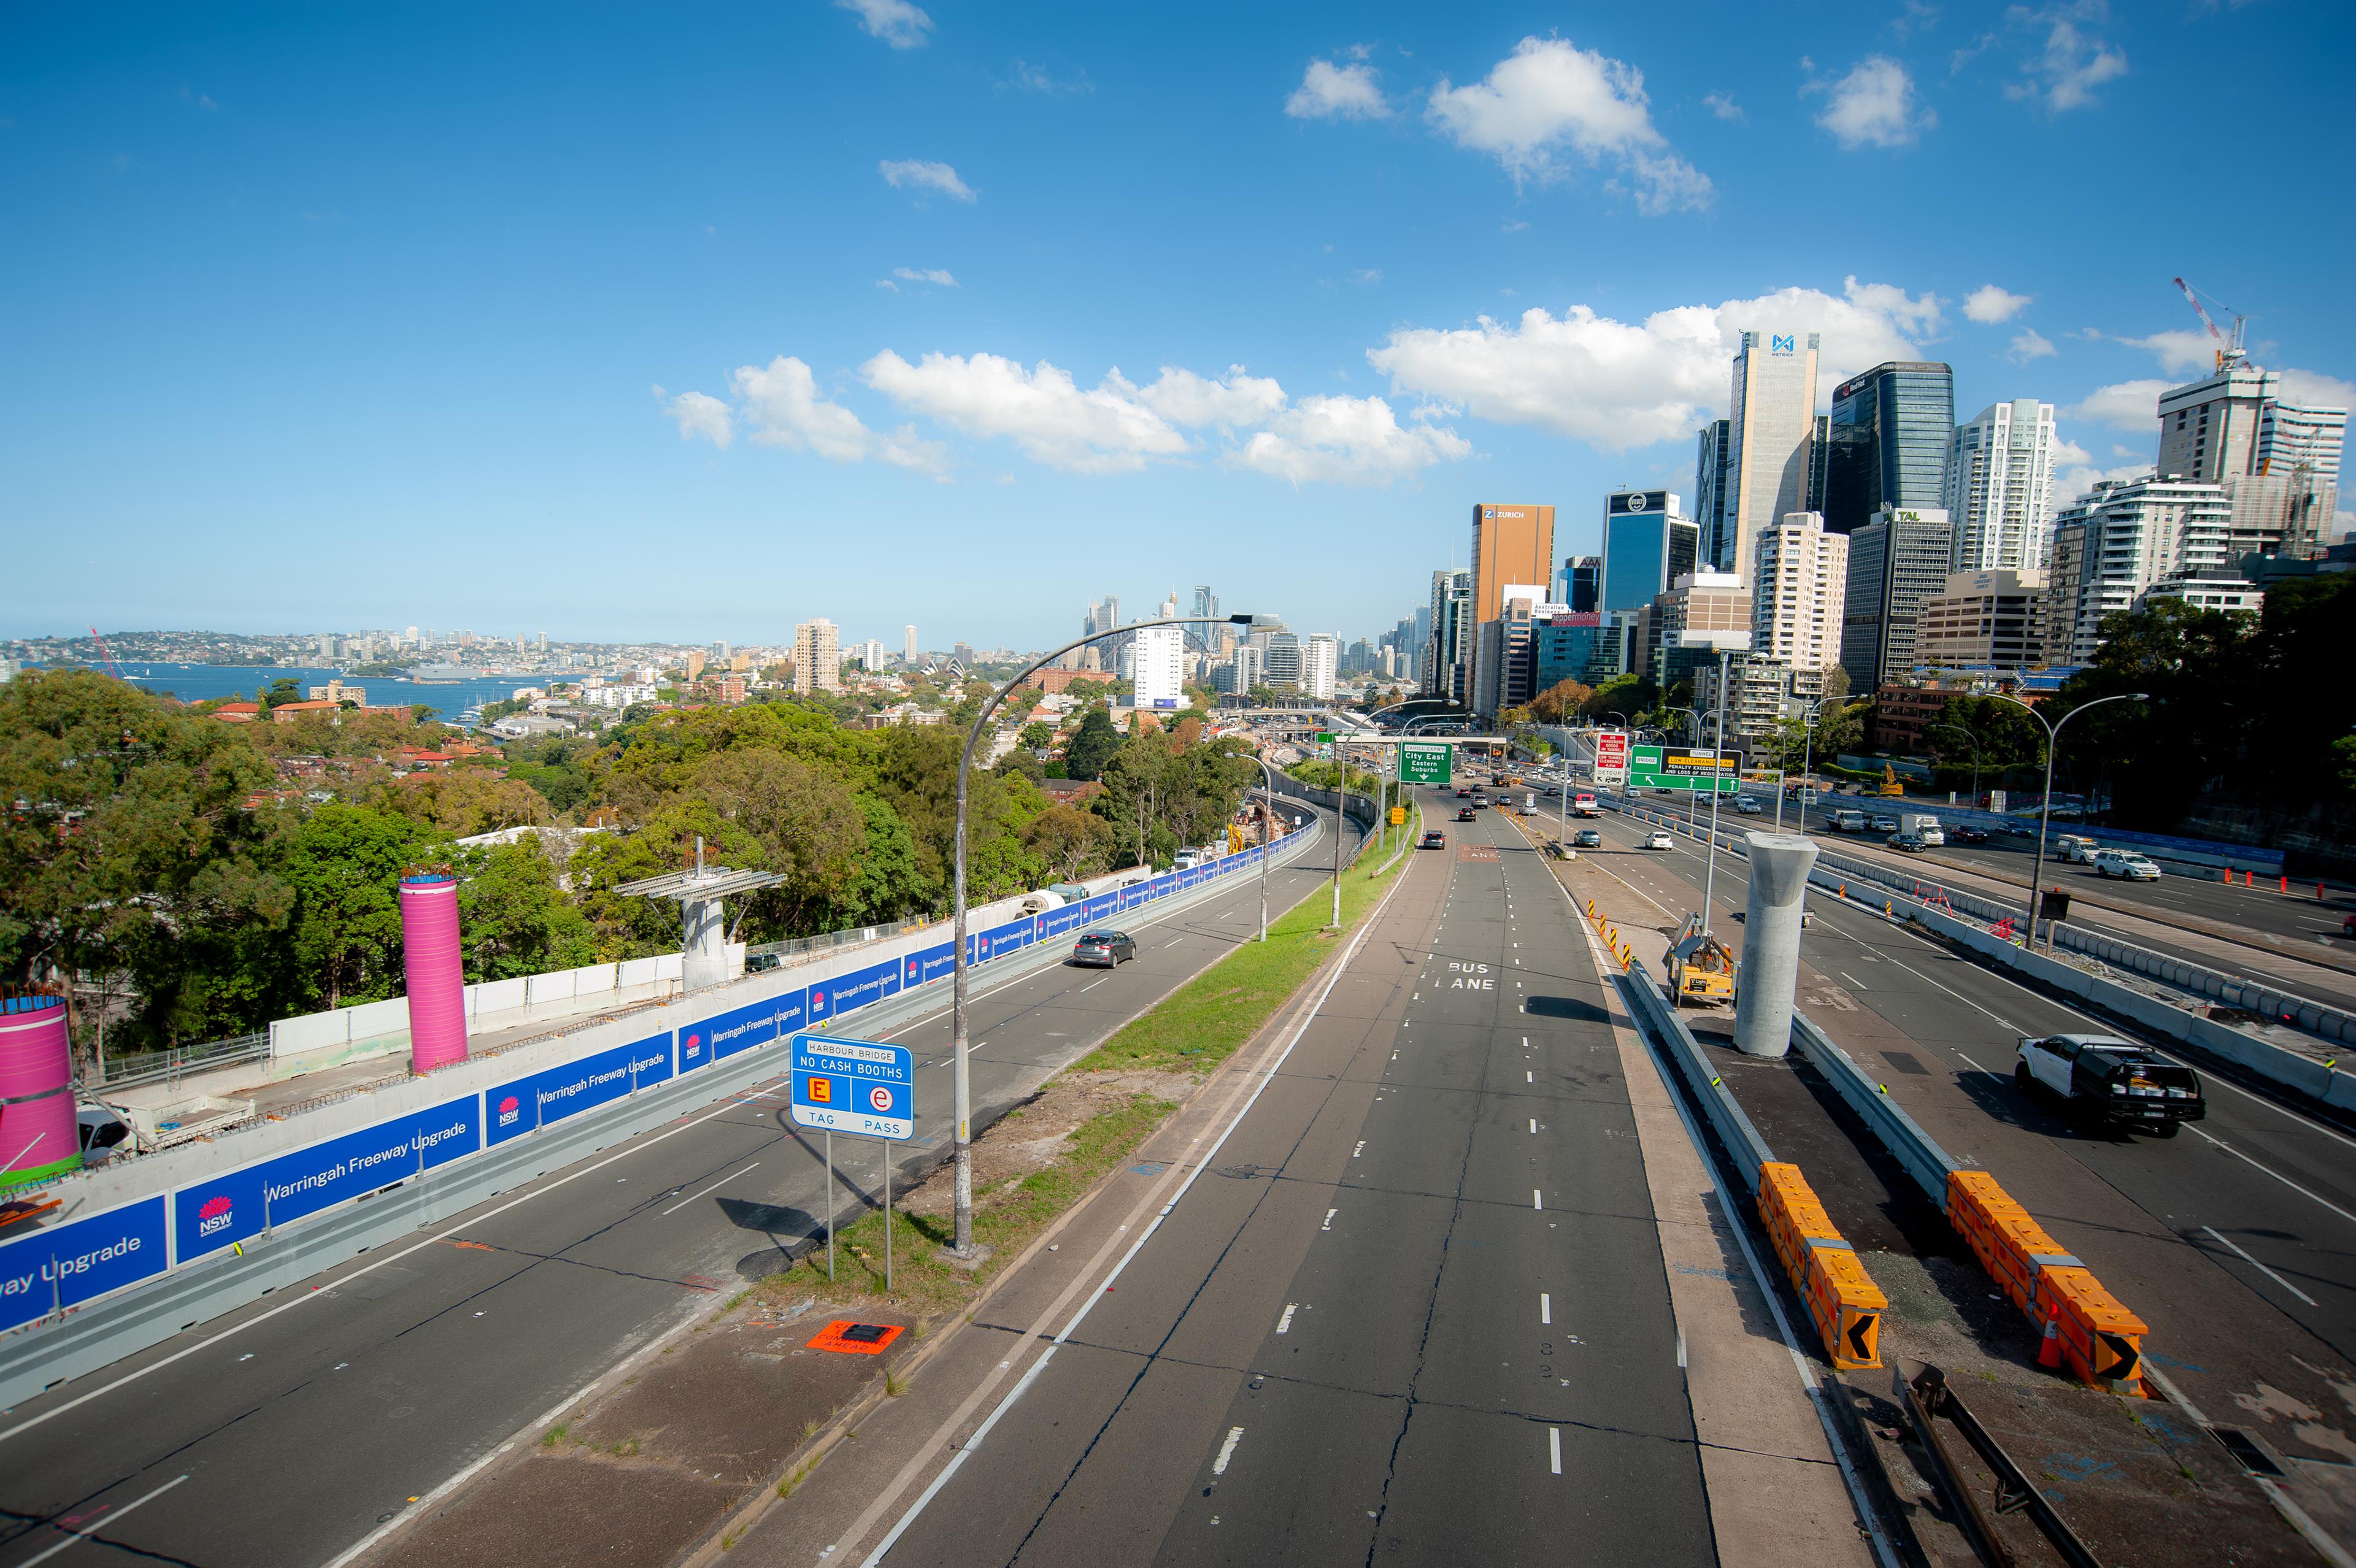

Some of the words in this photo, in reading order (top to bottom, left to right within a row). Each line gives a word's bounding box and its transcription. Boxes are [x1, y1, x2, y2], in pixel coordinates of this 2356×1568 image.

[1898, 512, 1920, 521] TAL
[1448, 963, 1488, 974] BUS
[833, 985, 858, 1001] Warringah
[859, 979, 879, 993] Freeway
[814, 1001, 824, 1010] NSW
[712, 1024, 745, 1043] Warringah
[747, 1015, 774, 1031] Freeway
[774, 1006, 800, 1022] Upgrade
[687, 1045, 700, 1056] NSW
[809, 1043, 853, 1056] HARBOUR
[858, 1050, 892, 1061] BRIDGE
[800, 1056, 815, 1067] NO
[821, 1058, 851, 1072] CASH
[858, 1063, 903, 1079] BOOTHS
[537, 1078, 587, 1105] Warringah
[589, 1066, 626, 1087] Freeway
[628, 1053, 664, 1074] Upgrade
[814, 1080, 826, 1099] E
[499, 1109, 518, 1124] NSW
[809, 1112, 834, 1124] TAG
[864, 1120, 900, 1134] PASS
[264, 1163, 345, 1203] Warringah
[349, 1142, 409, 1174] Freeway
[411, 1122, 466, 1150] Upgrade
[200, 1212, 233, 1233] NSW
[200, 1222, 233, 1237] GOVERNMENT
[41, 1237, 142, 1282] Upgrade
